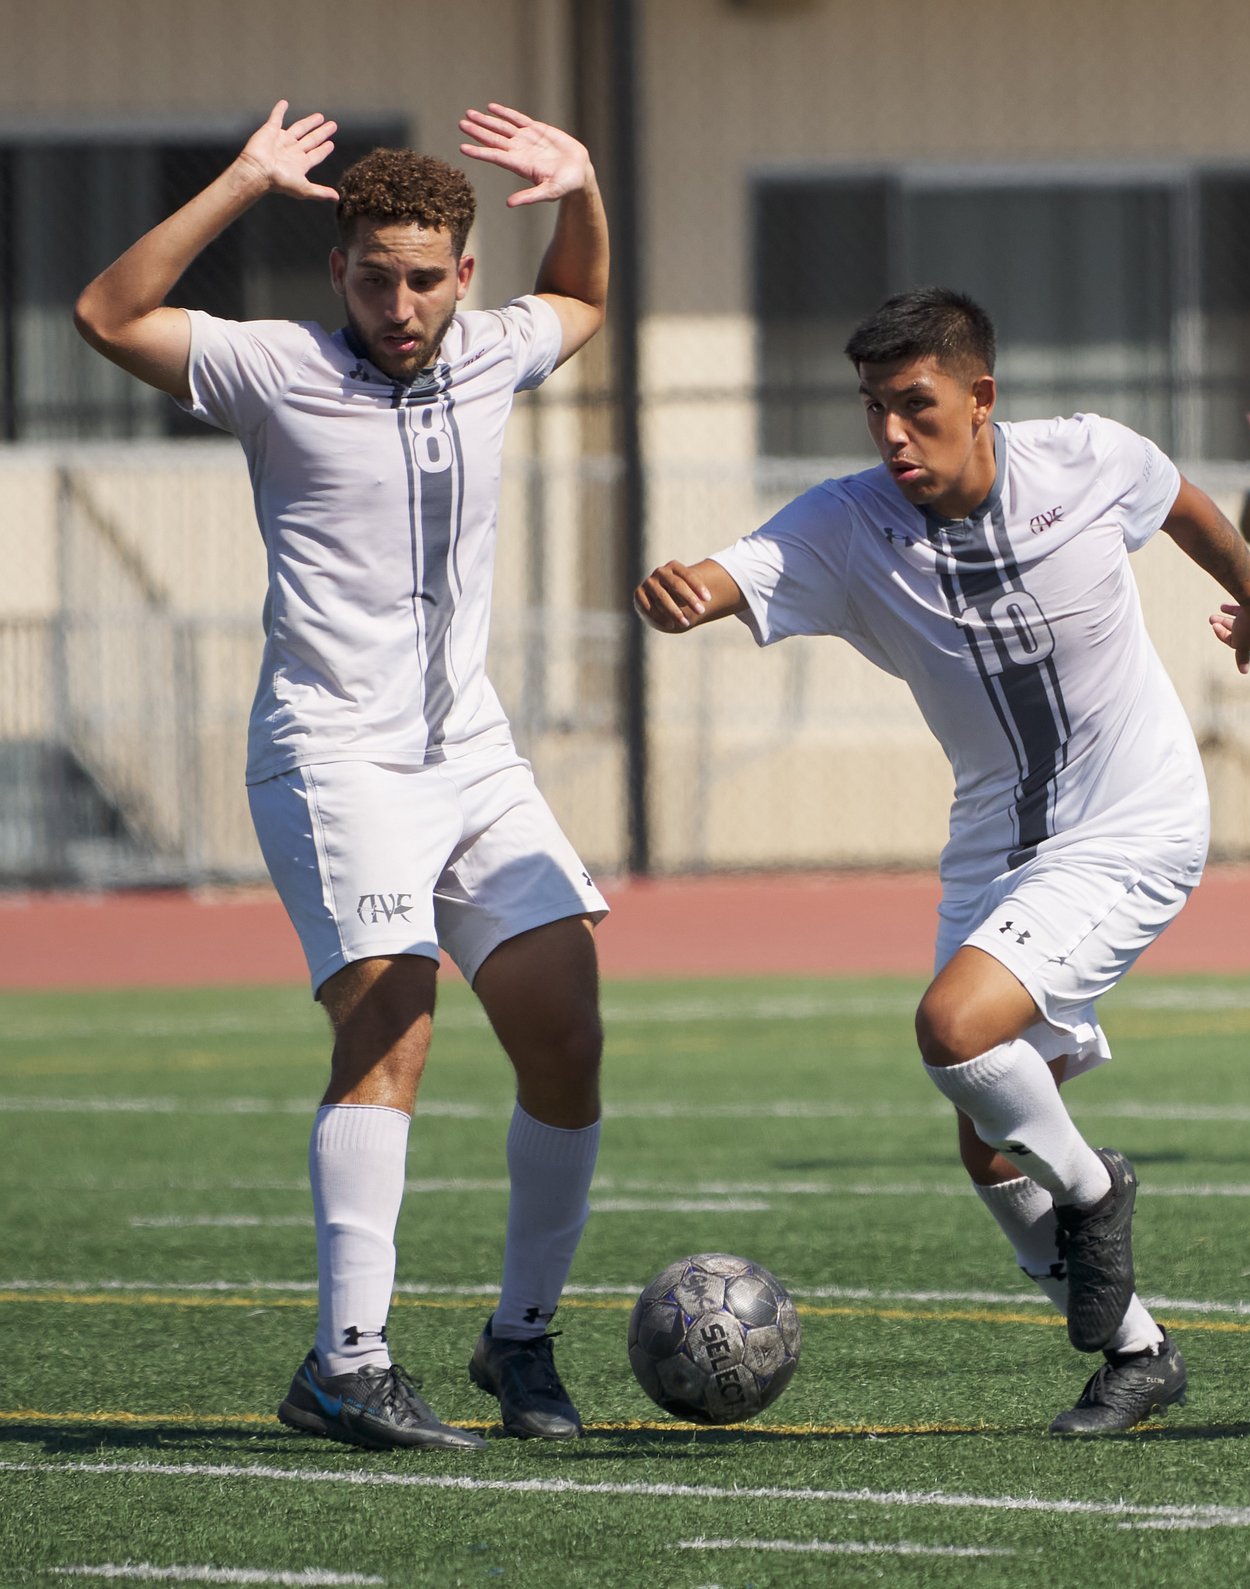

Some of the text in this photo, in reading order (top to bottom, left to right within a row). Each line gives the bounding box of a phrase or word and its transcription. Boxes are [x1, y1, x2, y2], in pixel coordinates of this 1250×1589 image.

[409, 402, 454, 474] 8
[953, 591, 1056, 678] 10
[700, 1322, 747, 1407] SELECT
